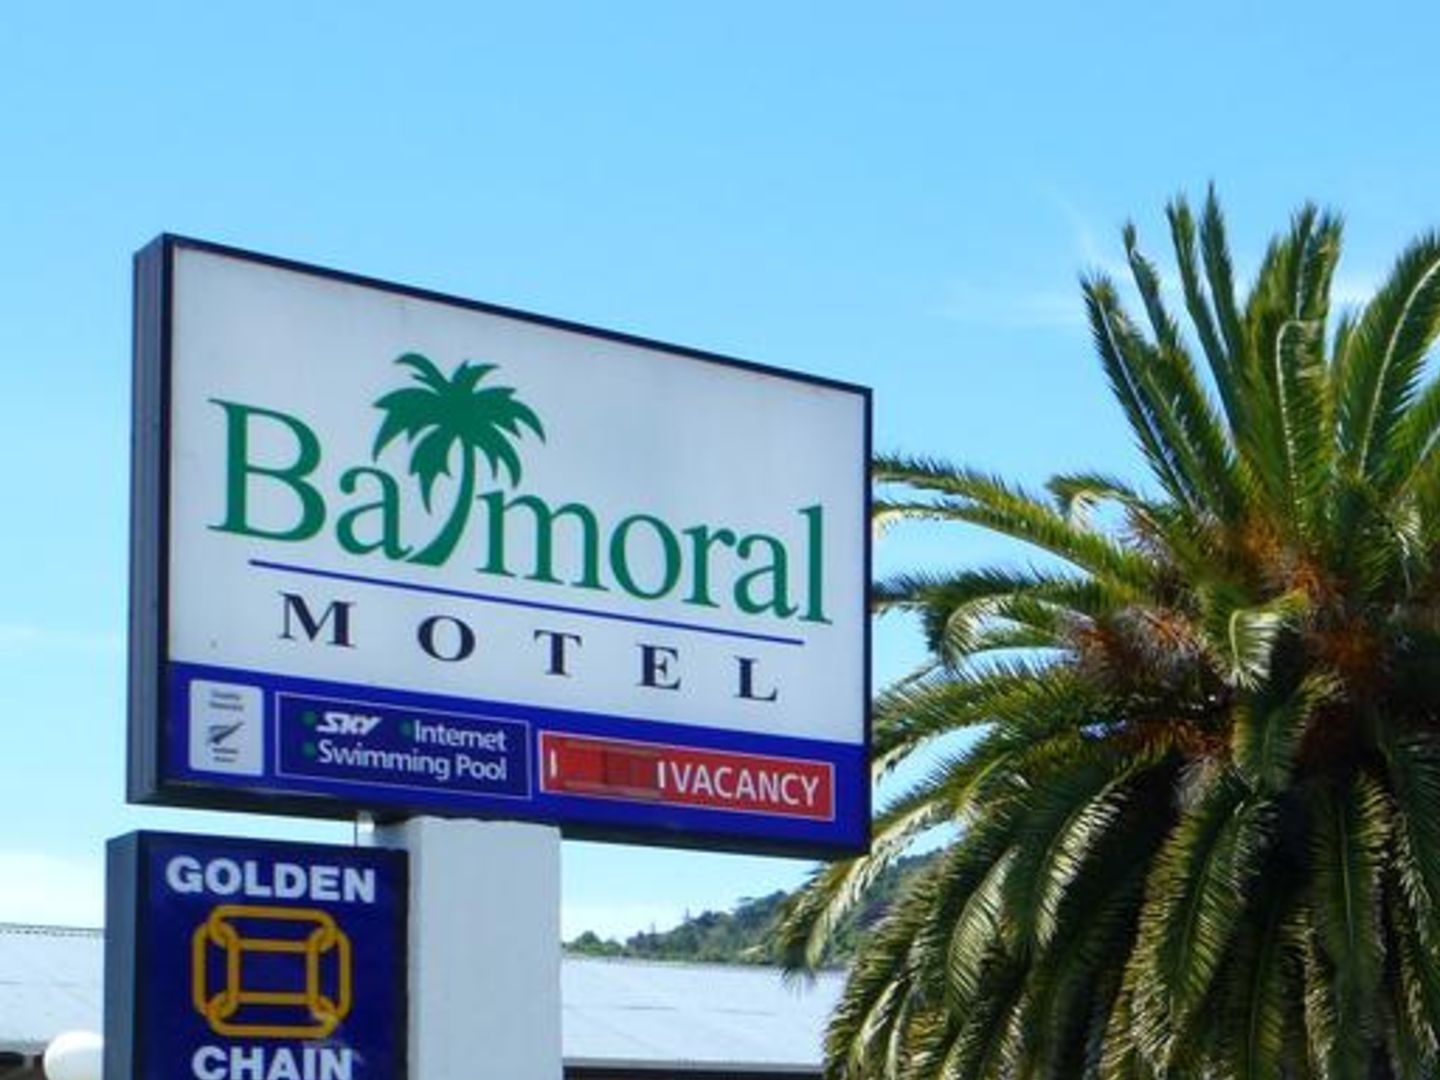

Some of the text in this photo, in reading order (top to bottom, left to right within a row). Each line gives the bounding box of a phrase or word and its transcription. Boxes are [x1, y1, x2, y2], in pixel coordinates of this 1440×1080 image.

[207, 396, 832, 625] Balmoral
[279, 592, 779, 702] MOTEL
[316, 711, 508, 752] SKY Internet
[319, 739, 508, 782] Swimming Pool
[671, 760, 820, 807] VACANCY
[165, 855, 376, 904] GOLDEN
